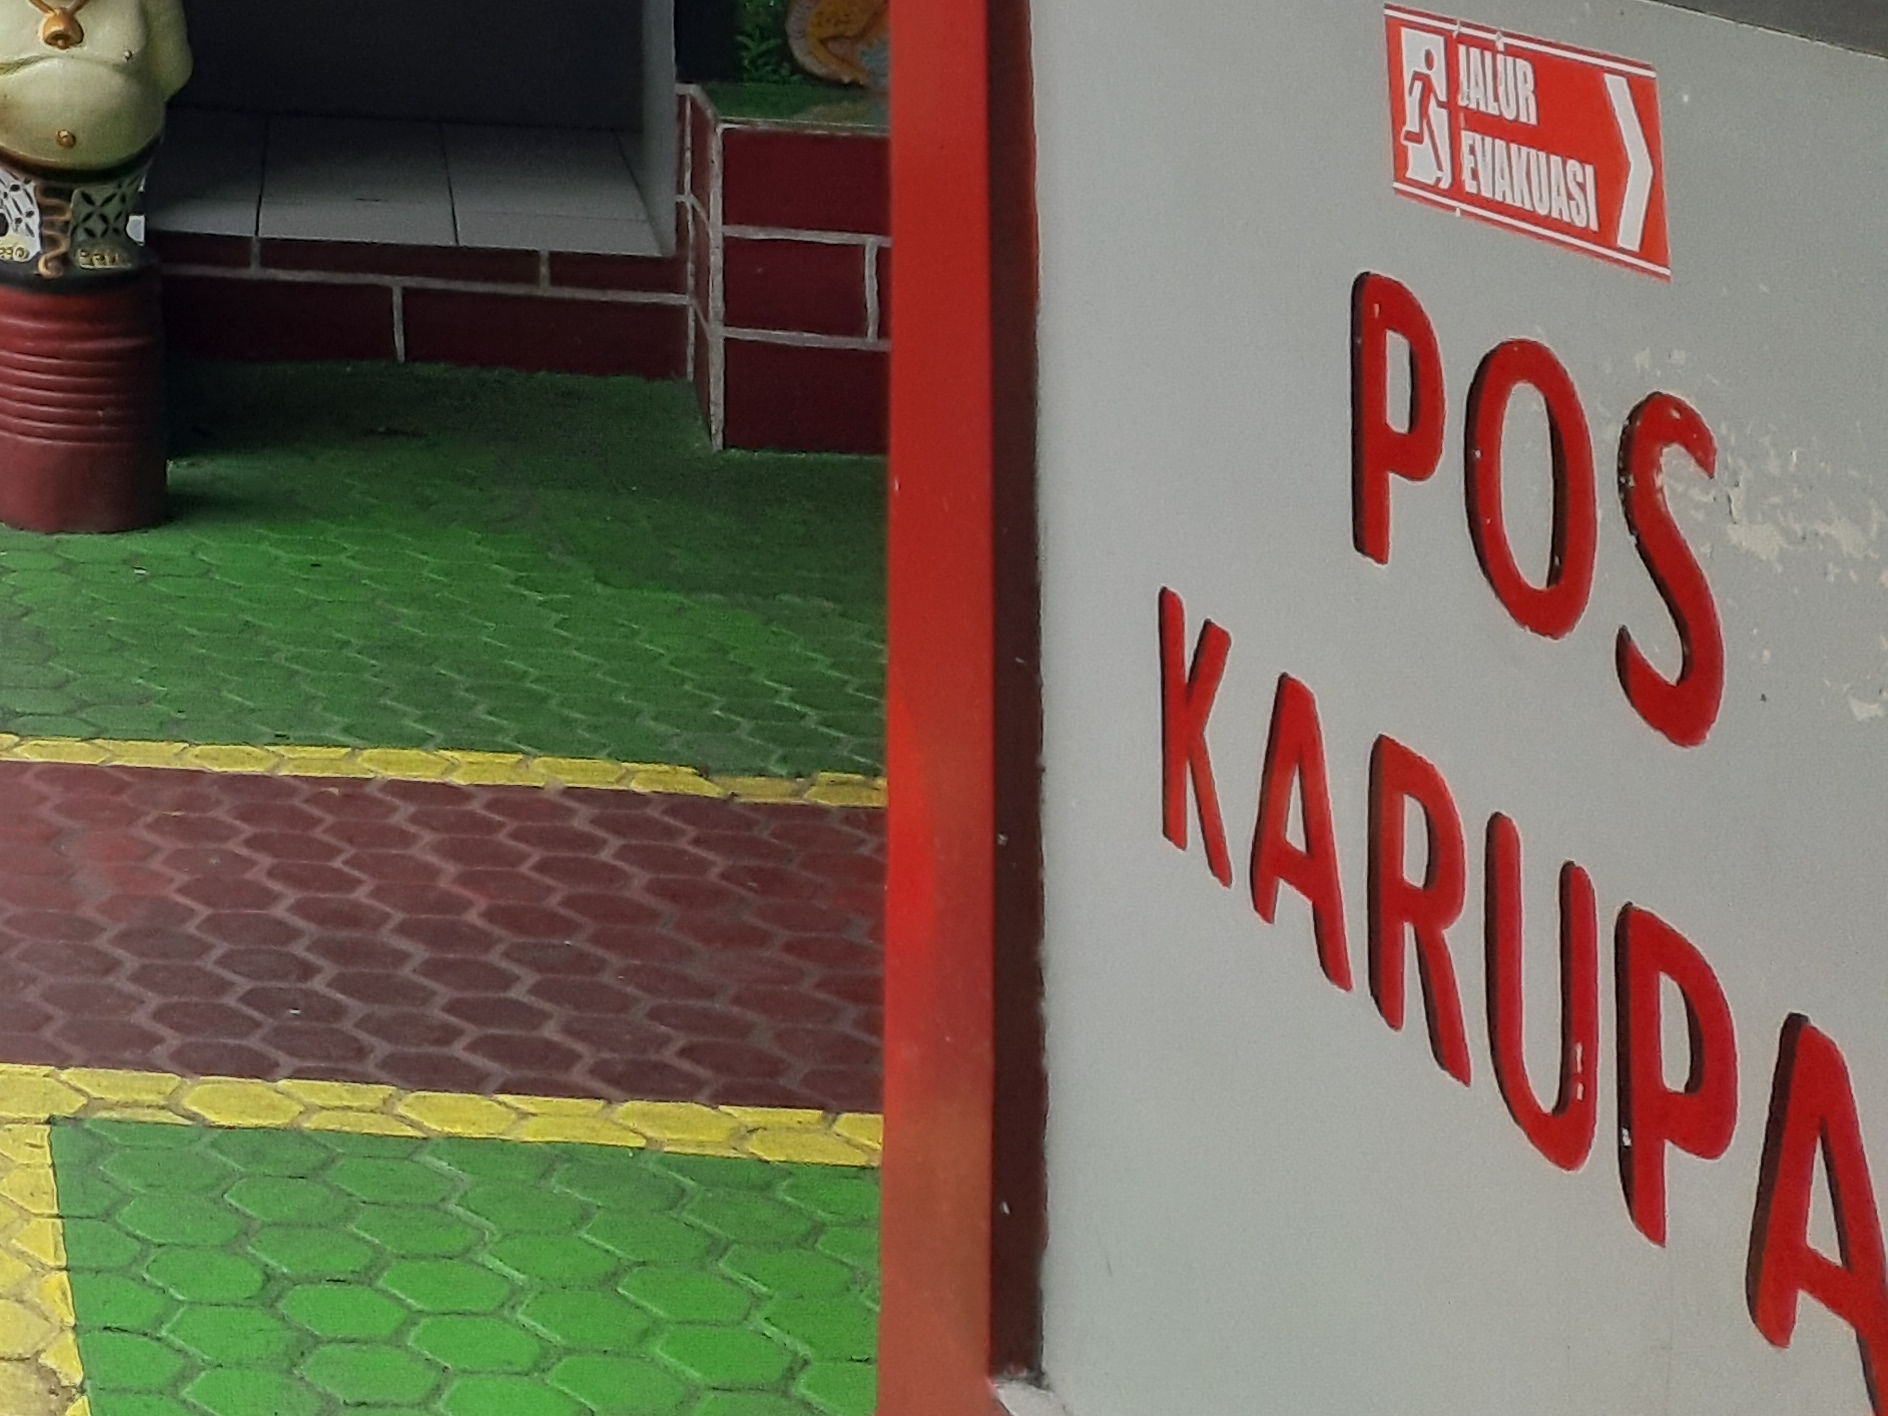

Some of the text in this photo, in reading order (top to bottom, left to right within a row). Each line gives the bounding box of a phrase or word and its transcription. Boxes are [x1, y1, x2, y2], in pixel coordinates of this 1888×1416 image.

[1457, 43, 1538, 127] JALUR
[1460, 129, 1599, 233] EVAKUASI
[1351, 272, 1725, 749] POS
[1159, 586, 1888, 1416] KARUPA
